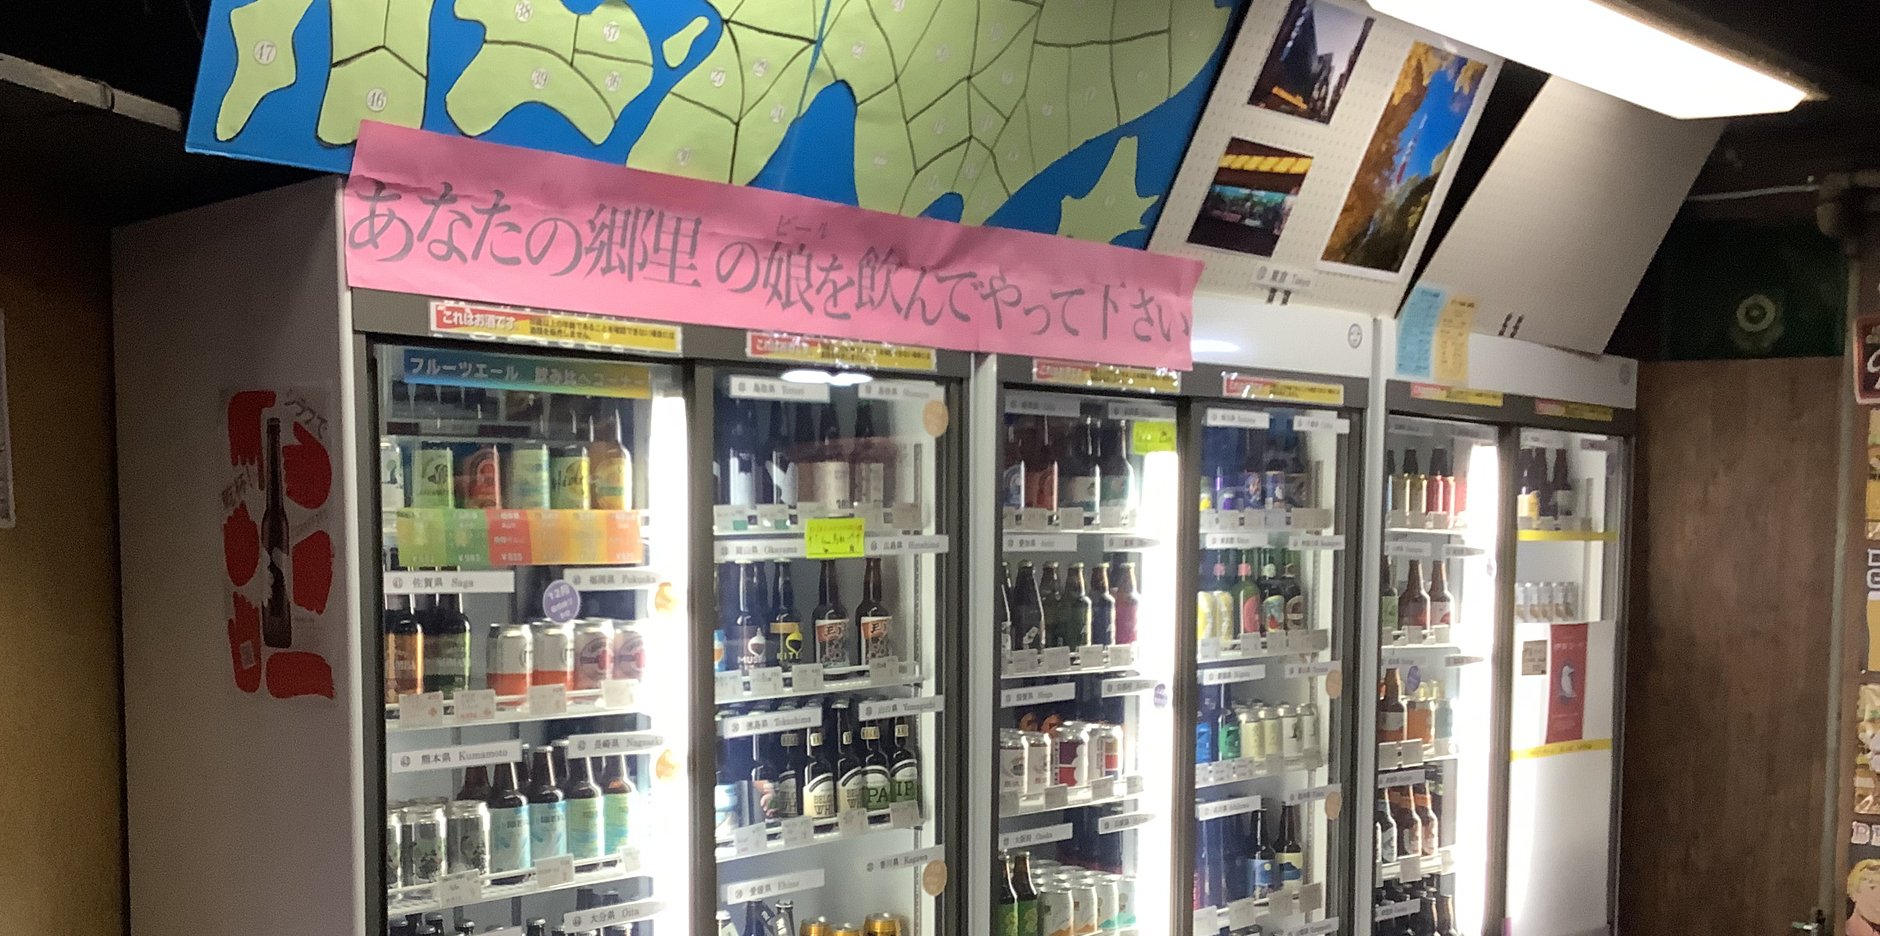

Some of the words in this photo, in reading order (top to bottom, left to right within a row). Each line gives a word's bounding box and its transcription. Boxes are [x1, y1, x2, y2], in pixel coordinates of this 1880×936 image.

[776, 214, 829, 239] ビール
[409, 357, 519, 381] フルーツエール
[451, 578, 473, 589] Saga
[421, 752, 451, 764] 熊本県
[459, 749, 508, 761] Kumamoto
